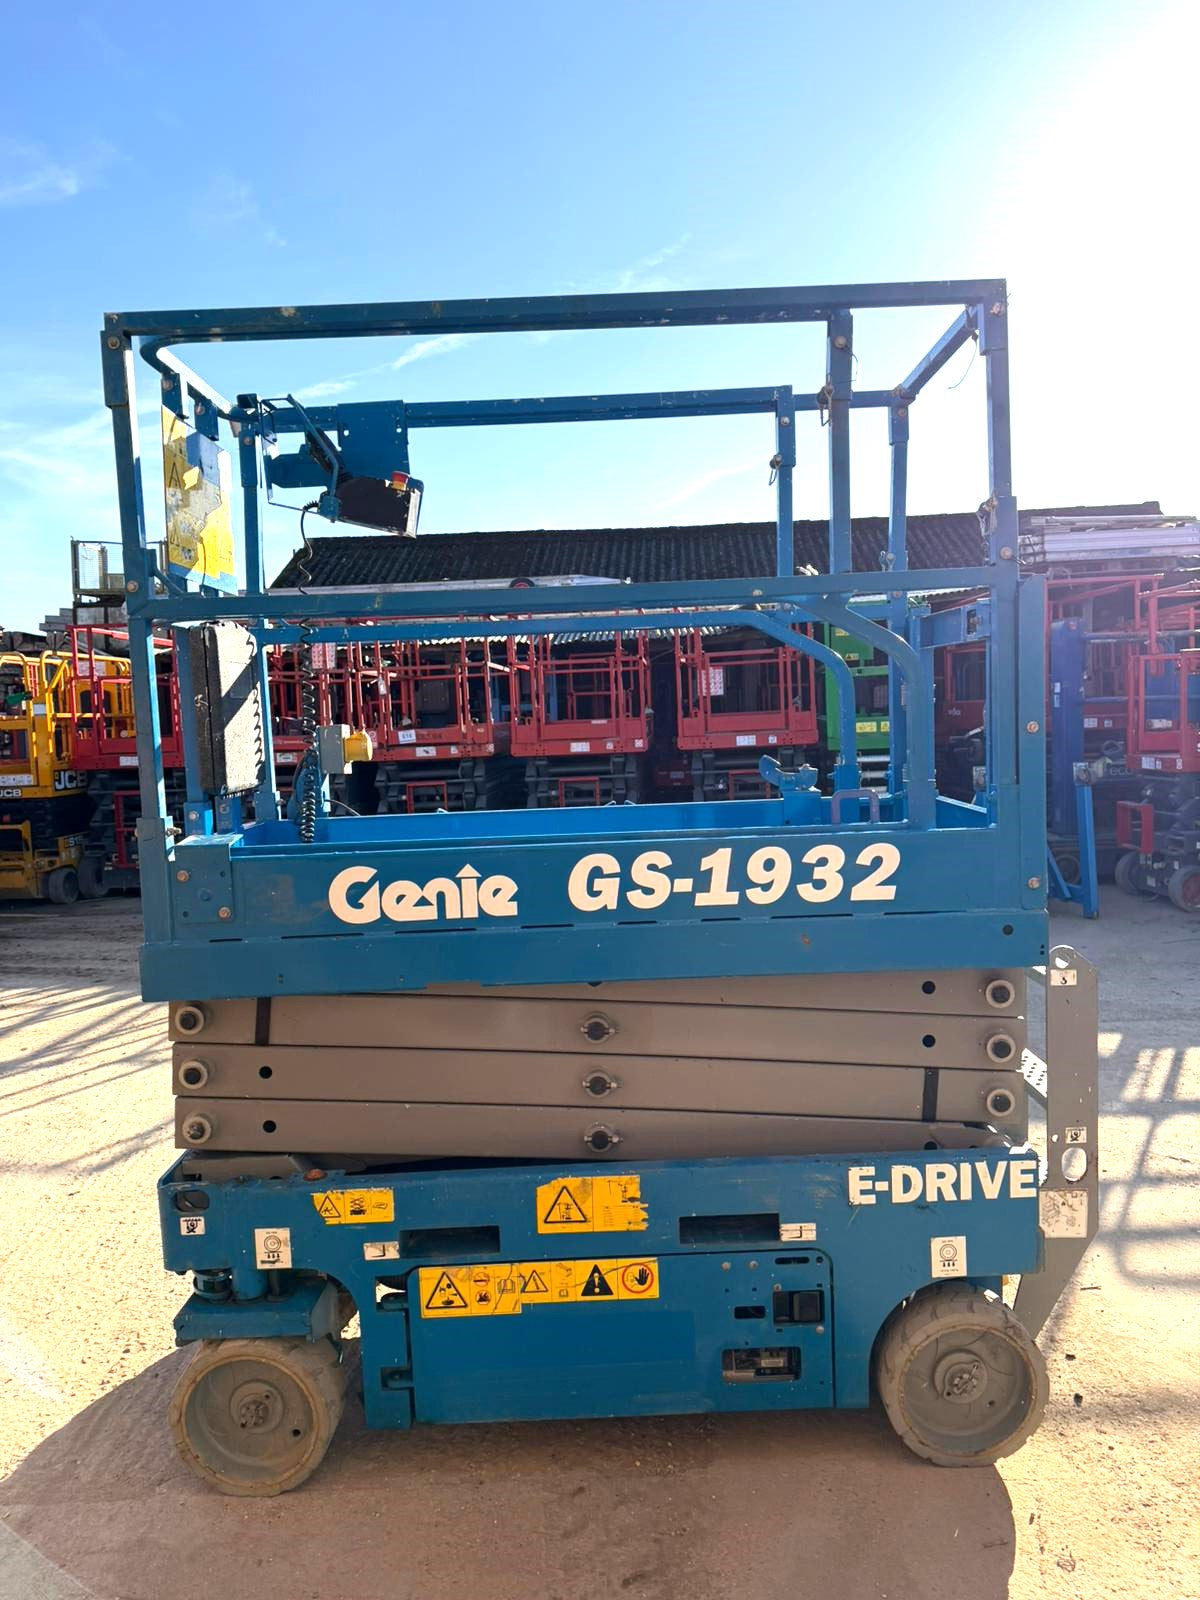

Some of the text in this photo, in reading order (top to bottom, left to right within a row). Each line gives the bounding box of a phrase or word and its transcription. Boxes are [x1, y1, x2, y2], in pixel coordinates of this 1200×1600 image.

[55, 770, 87, 790] JCB
[328, 843, 901, 924] Genie GS-1932
[848, 1160, 1037, 1205] E-DRIVE
